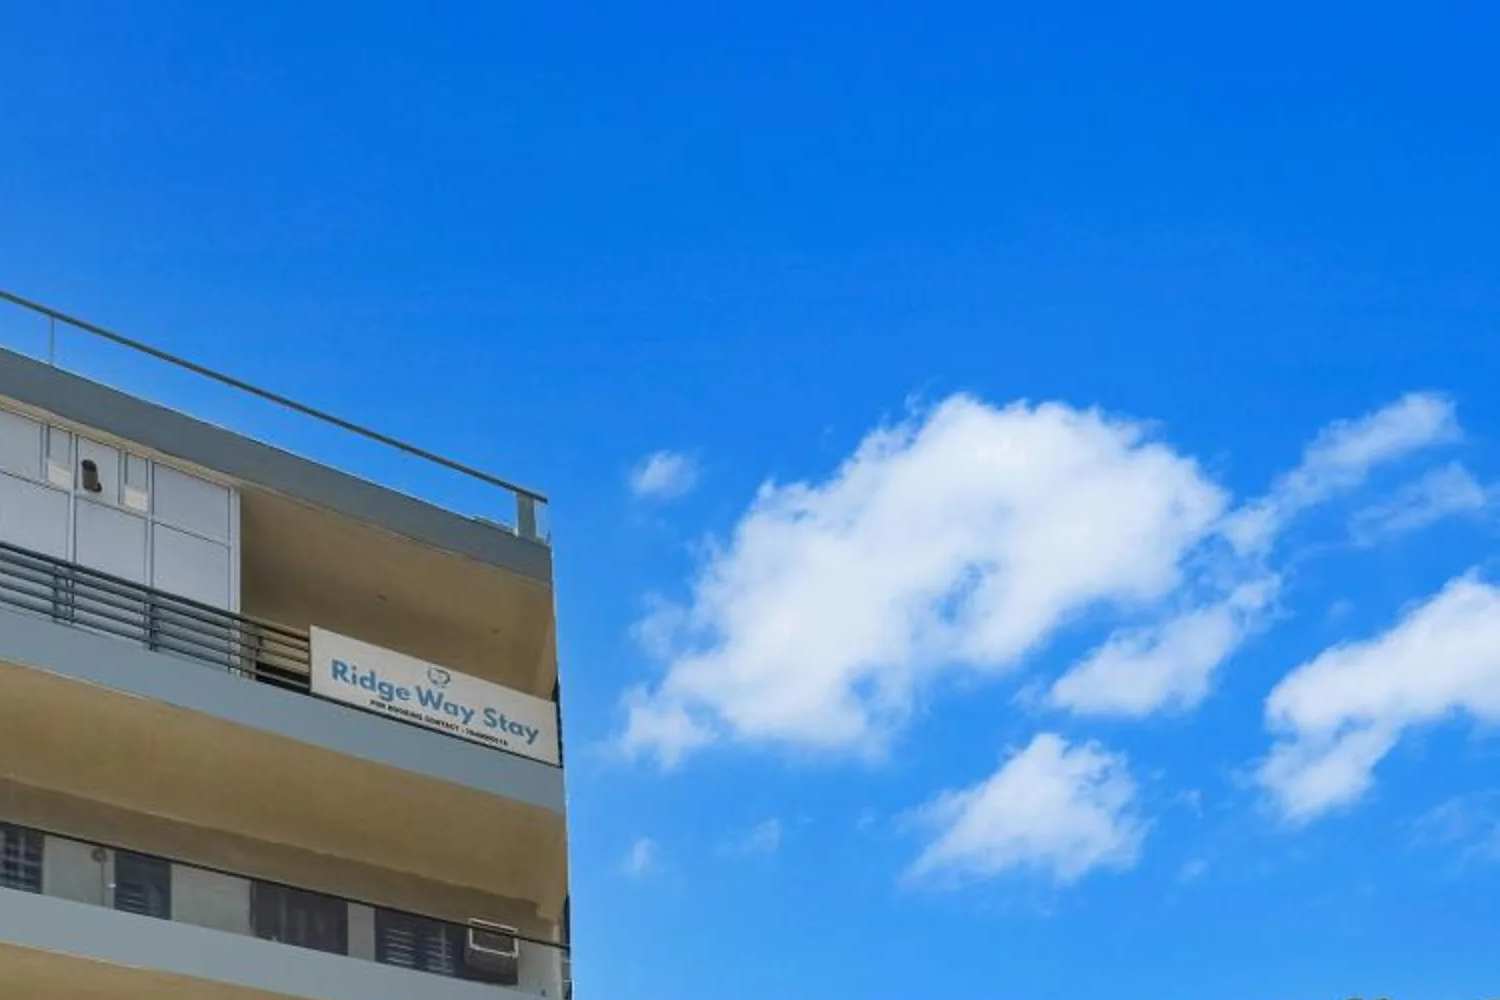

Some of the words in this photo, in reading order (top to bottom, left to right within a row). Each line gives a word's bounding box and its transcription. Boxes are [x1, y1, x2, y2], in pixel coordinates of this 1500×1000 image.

[331, 659, 410, 701] Ridge
[415, 684, 475, 724] Way
[483, 707, 539, 744] Stay
